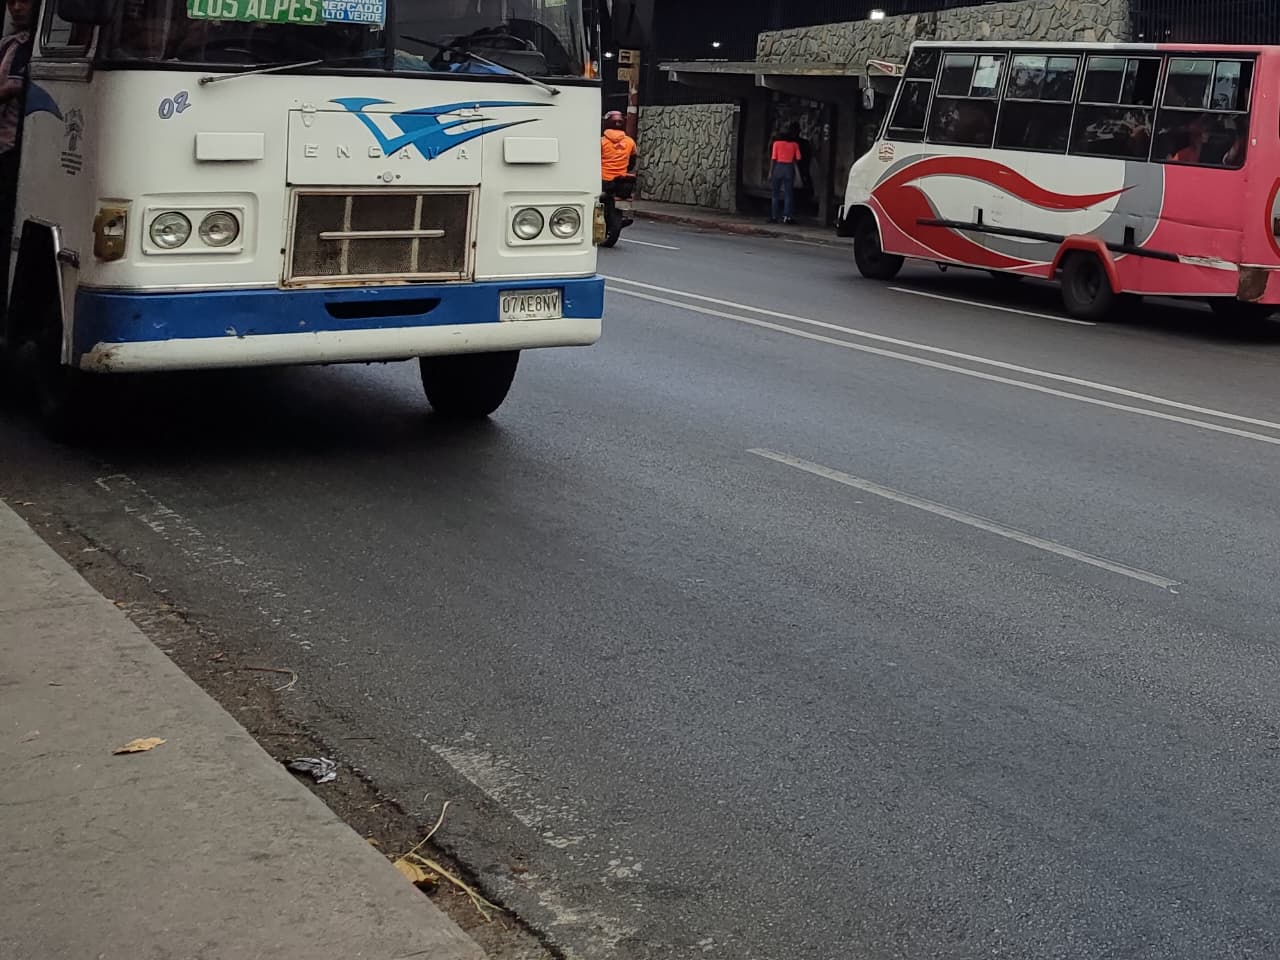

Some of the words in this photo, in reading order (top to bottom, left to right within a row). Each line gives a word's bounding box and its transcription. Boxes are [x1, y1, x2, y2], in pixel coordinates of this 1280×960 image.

[321, 0, 382, 14] MERCADO
[347, 10, 381, 22] VERDE
[158, 91, 192, 119] 02
[502, 295, 558, 313] 07AE8NV
